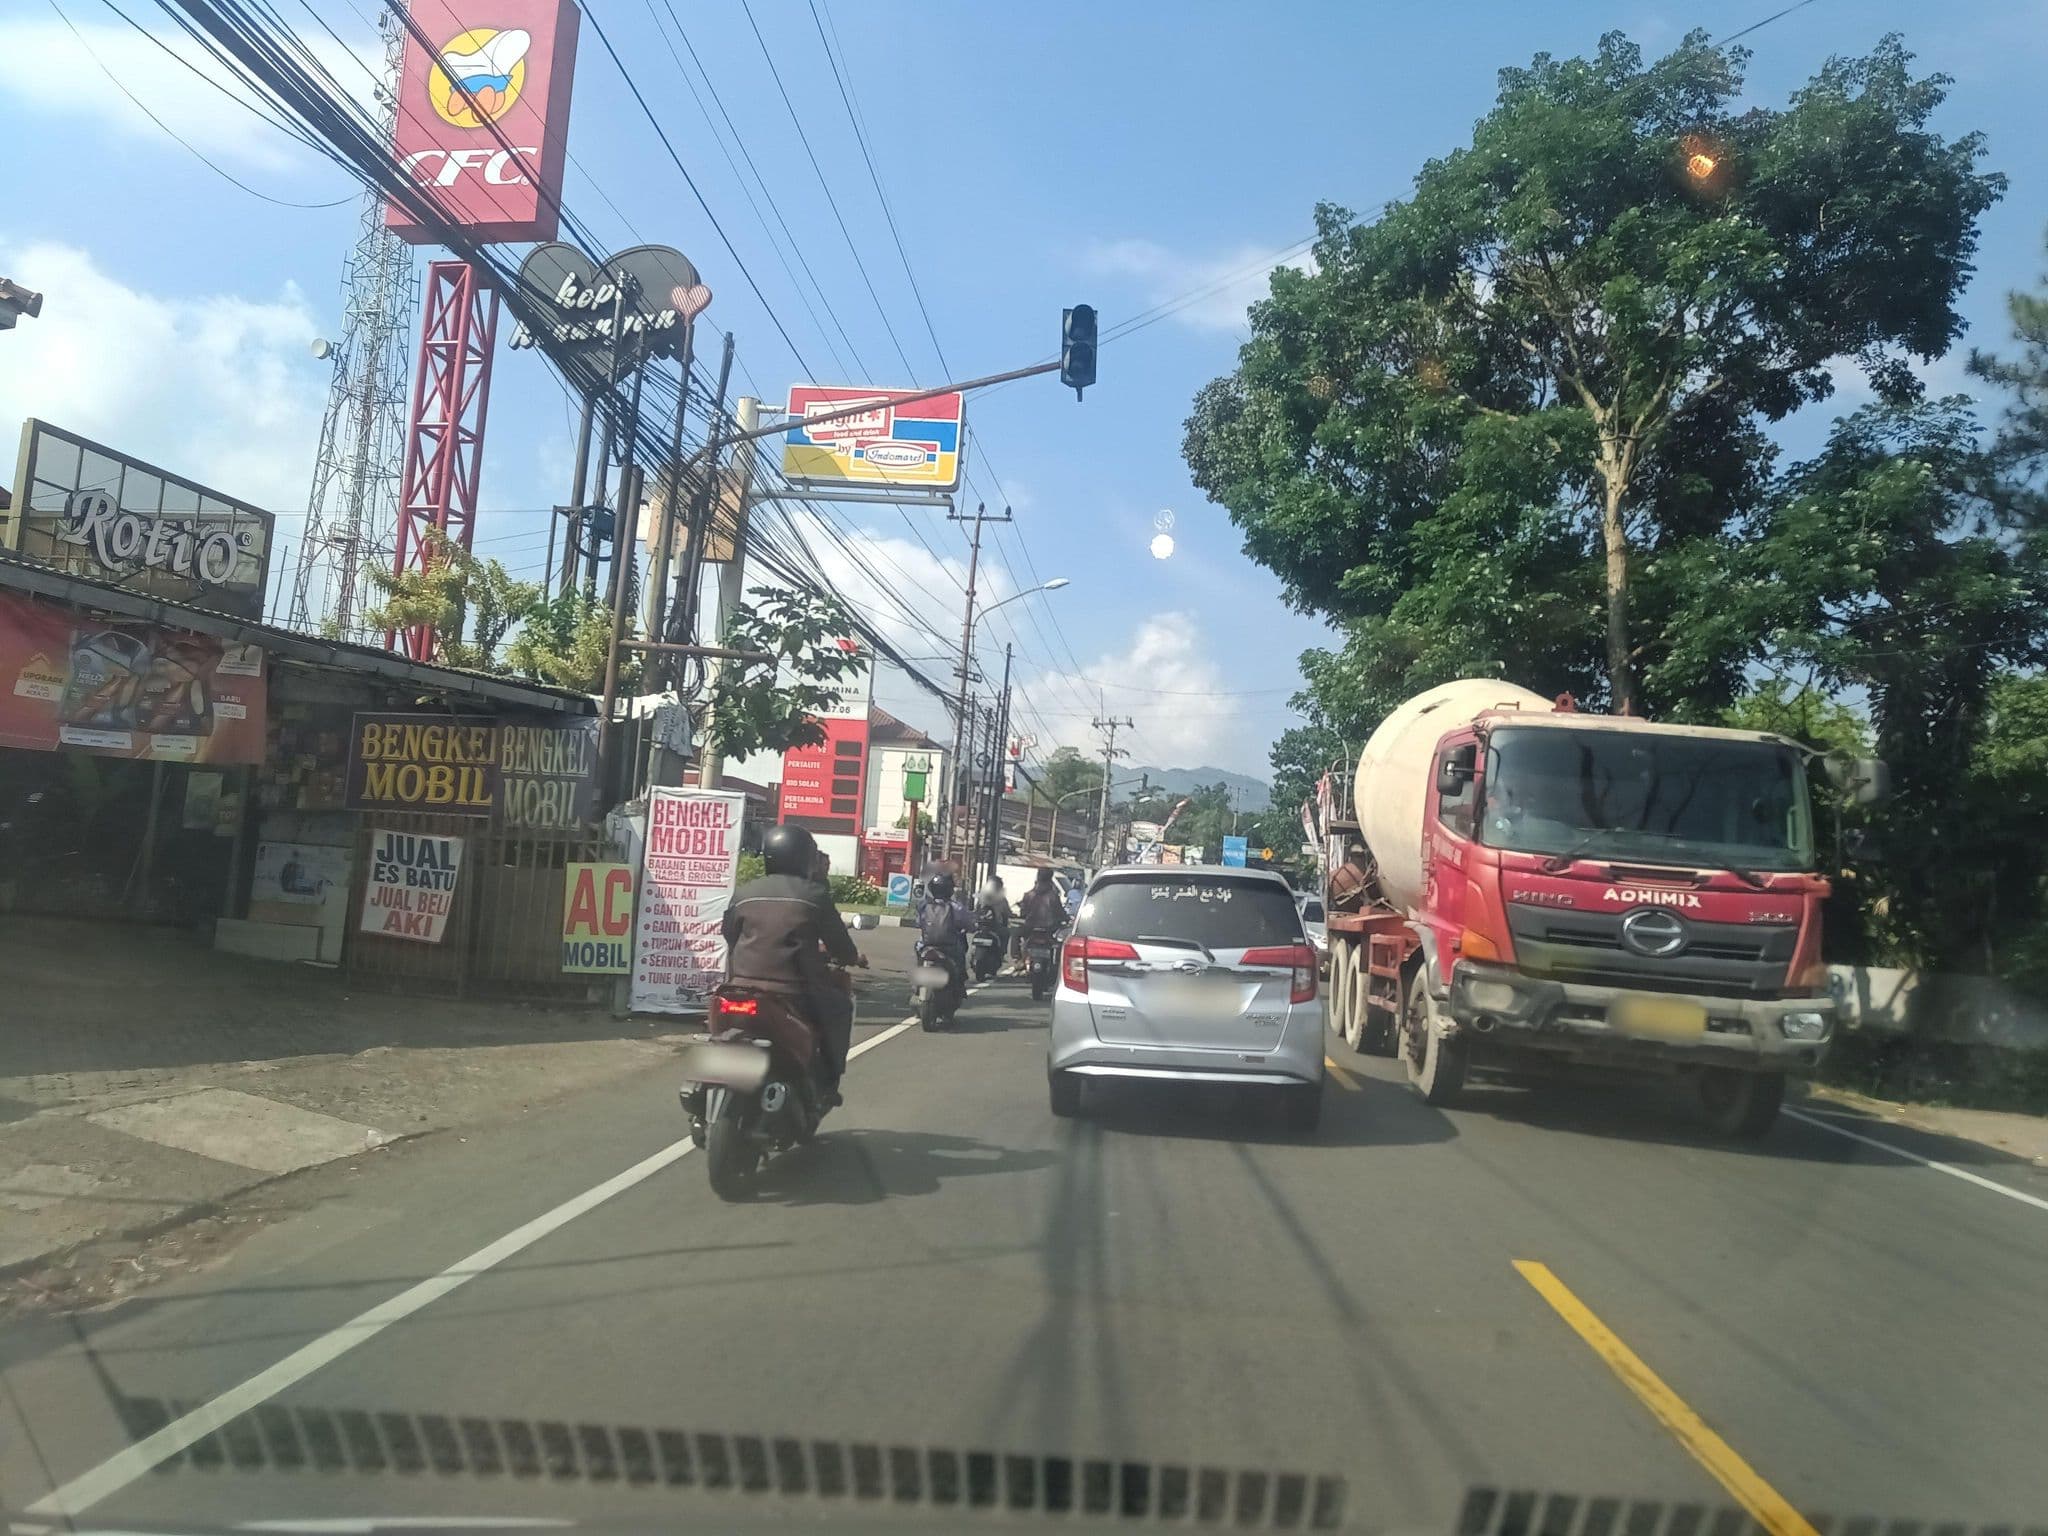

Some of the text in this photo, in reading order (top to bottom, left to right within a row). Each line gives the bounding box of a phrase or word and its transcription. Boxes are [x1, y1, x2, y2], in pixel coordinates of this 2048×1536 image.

[399, 146, 538, 187] CFC
[838, 443, 851, 455] by
[868, 449, 922, 464] Indomaret
[501, 725, 589, 777] BENGKEL
[788, 761, 820, 769] PERTALITE
[361, 763, 493, 806] MOBIL
[798, 780, 820, 788] SOLAR
[504, 778, 581, 832] MOBIL
[784, 795, 824, 804] PERTAMINA
[653, 799, 732, 829] BENGKEL
[651, 826, 729, 856] MOBIL
[376, 834, 456, 871] JUAL
[648, 858, 730, 874] BARANG LENGKAP
[374, 863, 456, 892] ES BATU
[371, 886, 450, 916] JUAL BELI
[565, 868, 632, 936] AC
[655, 886, 697, 900] JUAL AKI
[653, 905, 699, 918] GANTI OLI
[382, 910, 433, 938] AKI
[652, 920, 681, 934] GANTI
[563, 942, 628, 968] MOBIL
[651, 938, 716, 952] TURUN MESIN
[648, 954, 721, 970] SERVICE MOBIL
[648, 972, 672, 985] TUNE
